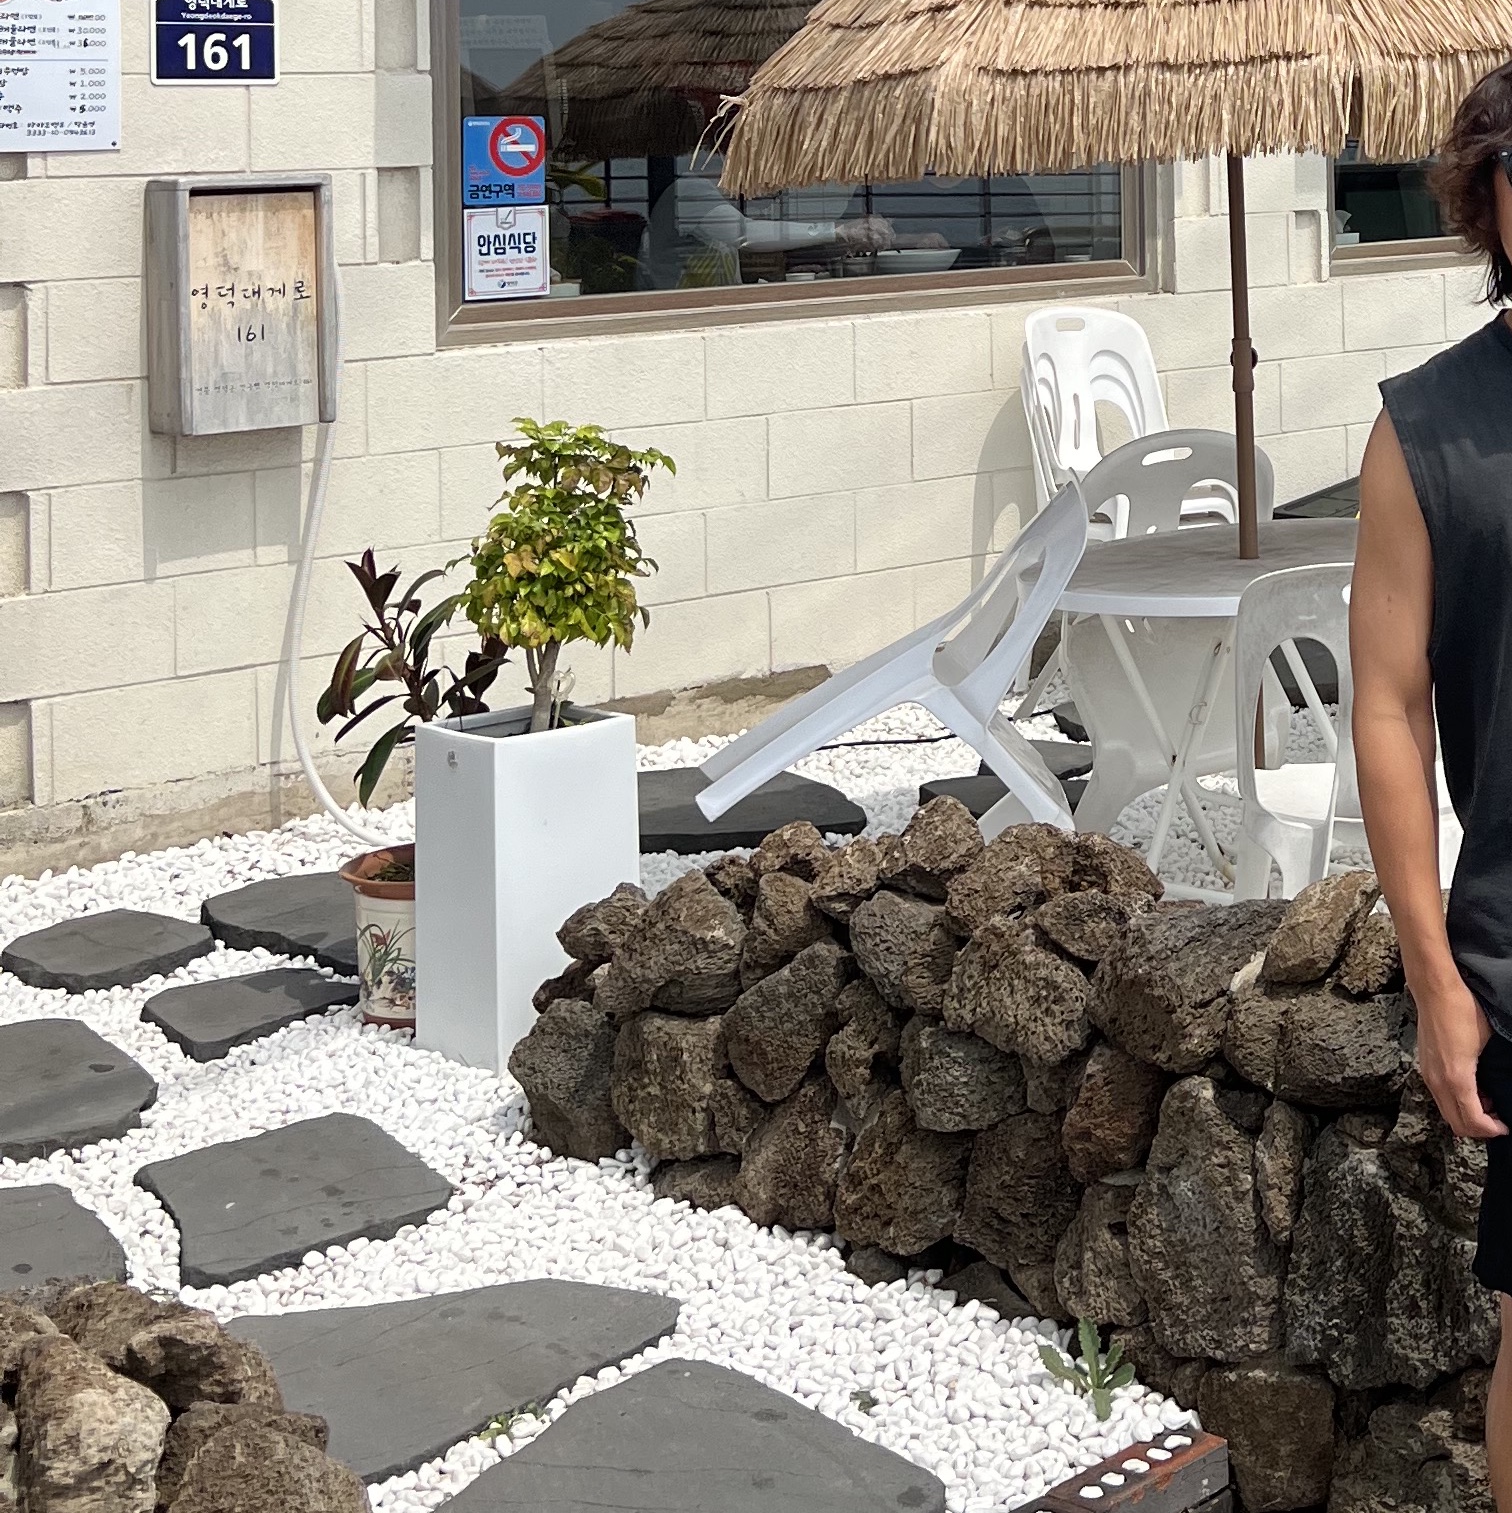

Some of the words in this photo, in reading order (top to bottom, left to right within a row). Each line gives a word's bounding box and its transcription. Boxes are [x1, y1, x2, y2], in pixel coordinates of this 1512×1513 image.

[177, 32, 251, 71] 161
[468, 183, 515, 199] 금연구역
[477, 232, 537, 256] 안심식당
[191, 280, 311, 310] 영덕대게로
[237, 324, 266, 343] 161
